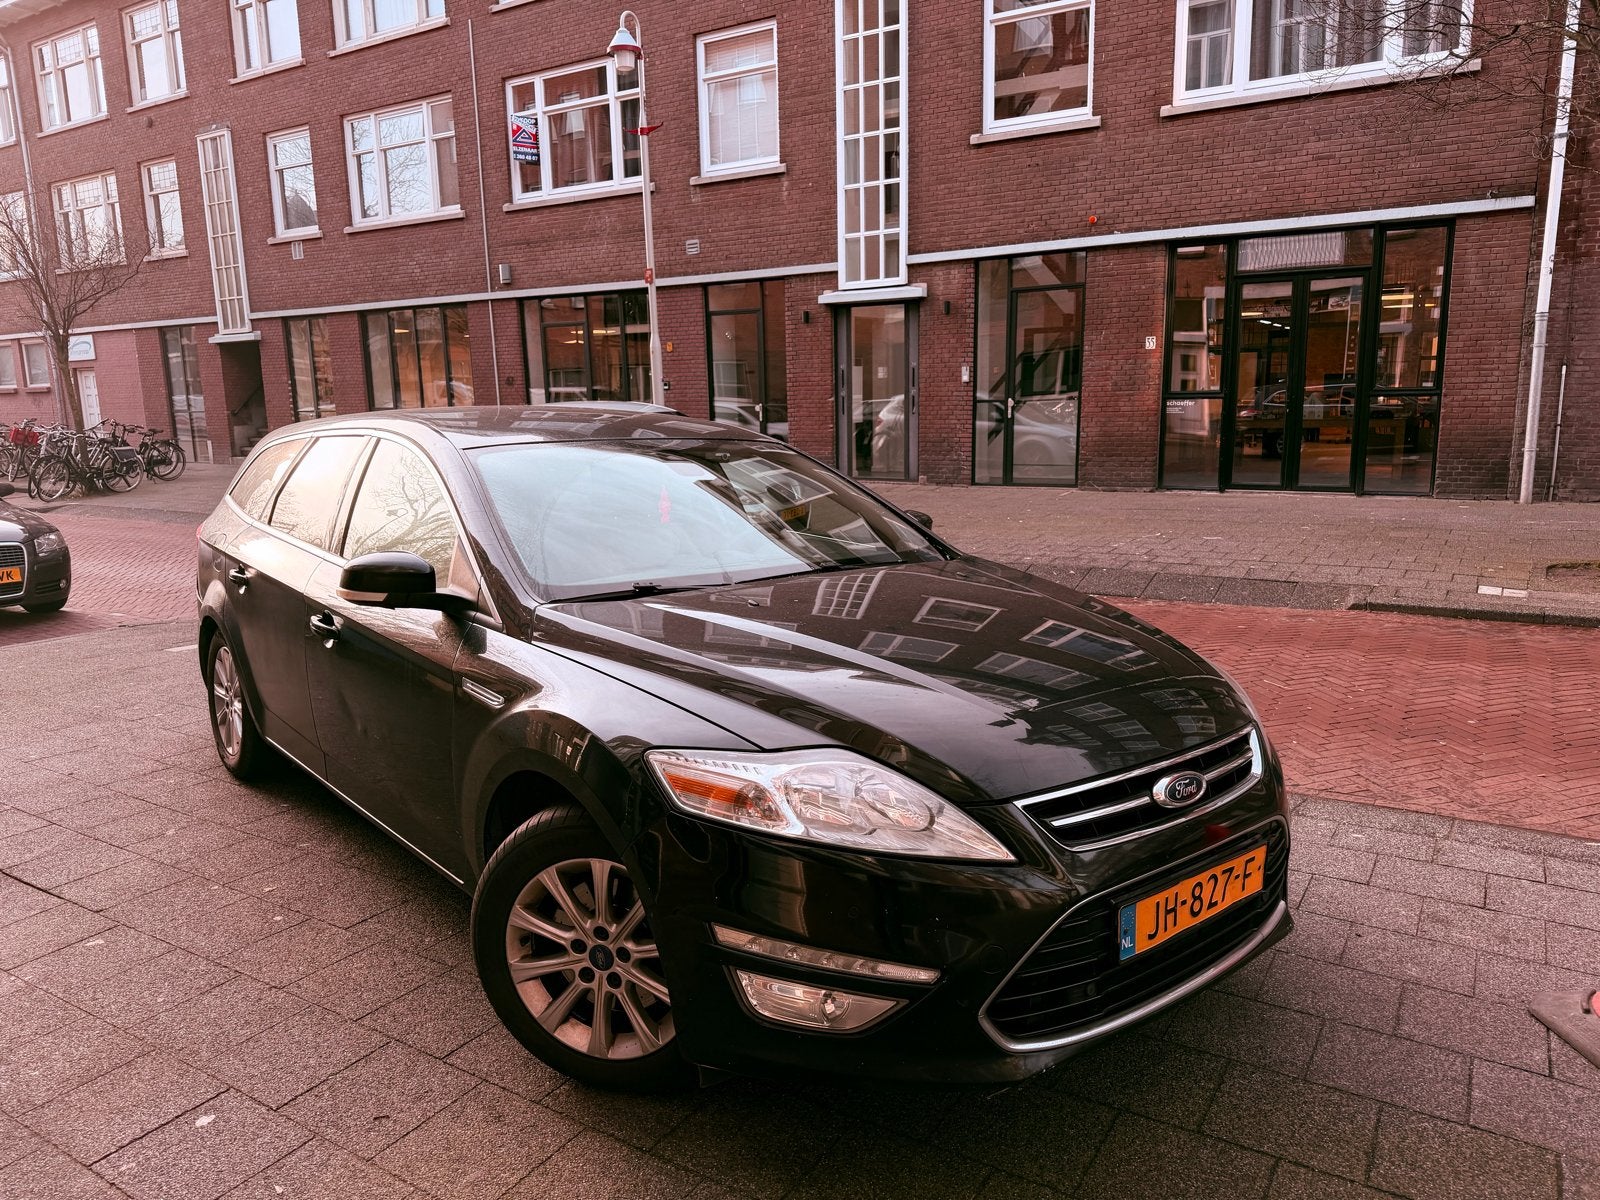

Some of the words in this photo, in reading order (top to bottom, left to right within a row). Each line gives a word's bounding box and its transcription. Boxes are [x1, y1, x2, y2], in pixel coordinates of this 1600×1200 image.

[1175, 779, 1198, 799] Ford
[1147, 855, 1256, 940] JH-827-F
[1121, 936, 1134, 950] NL
